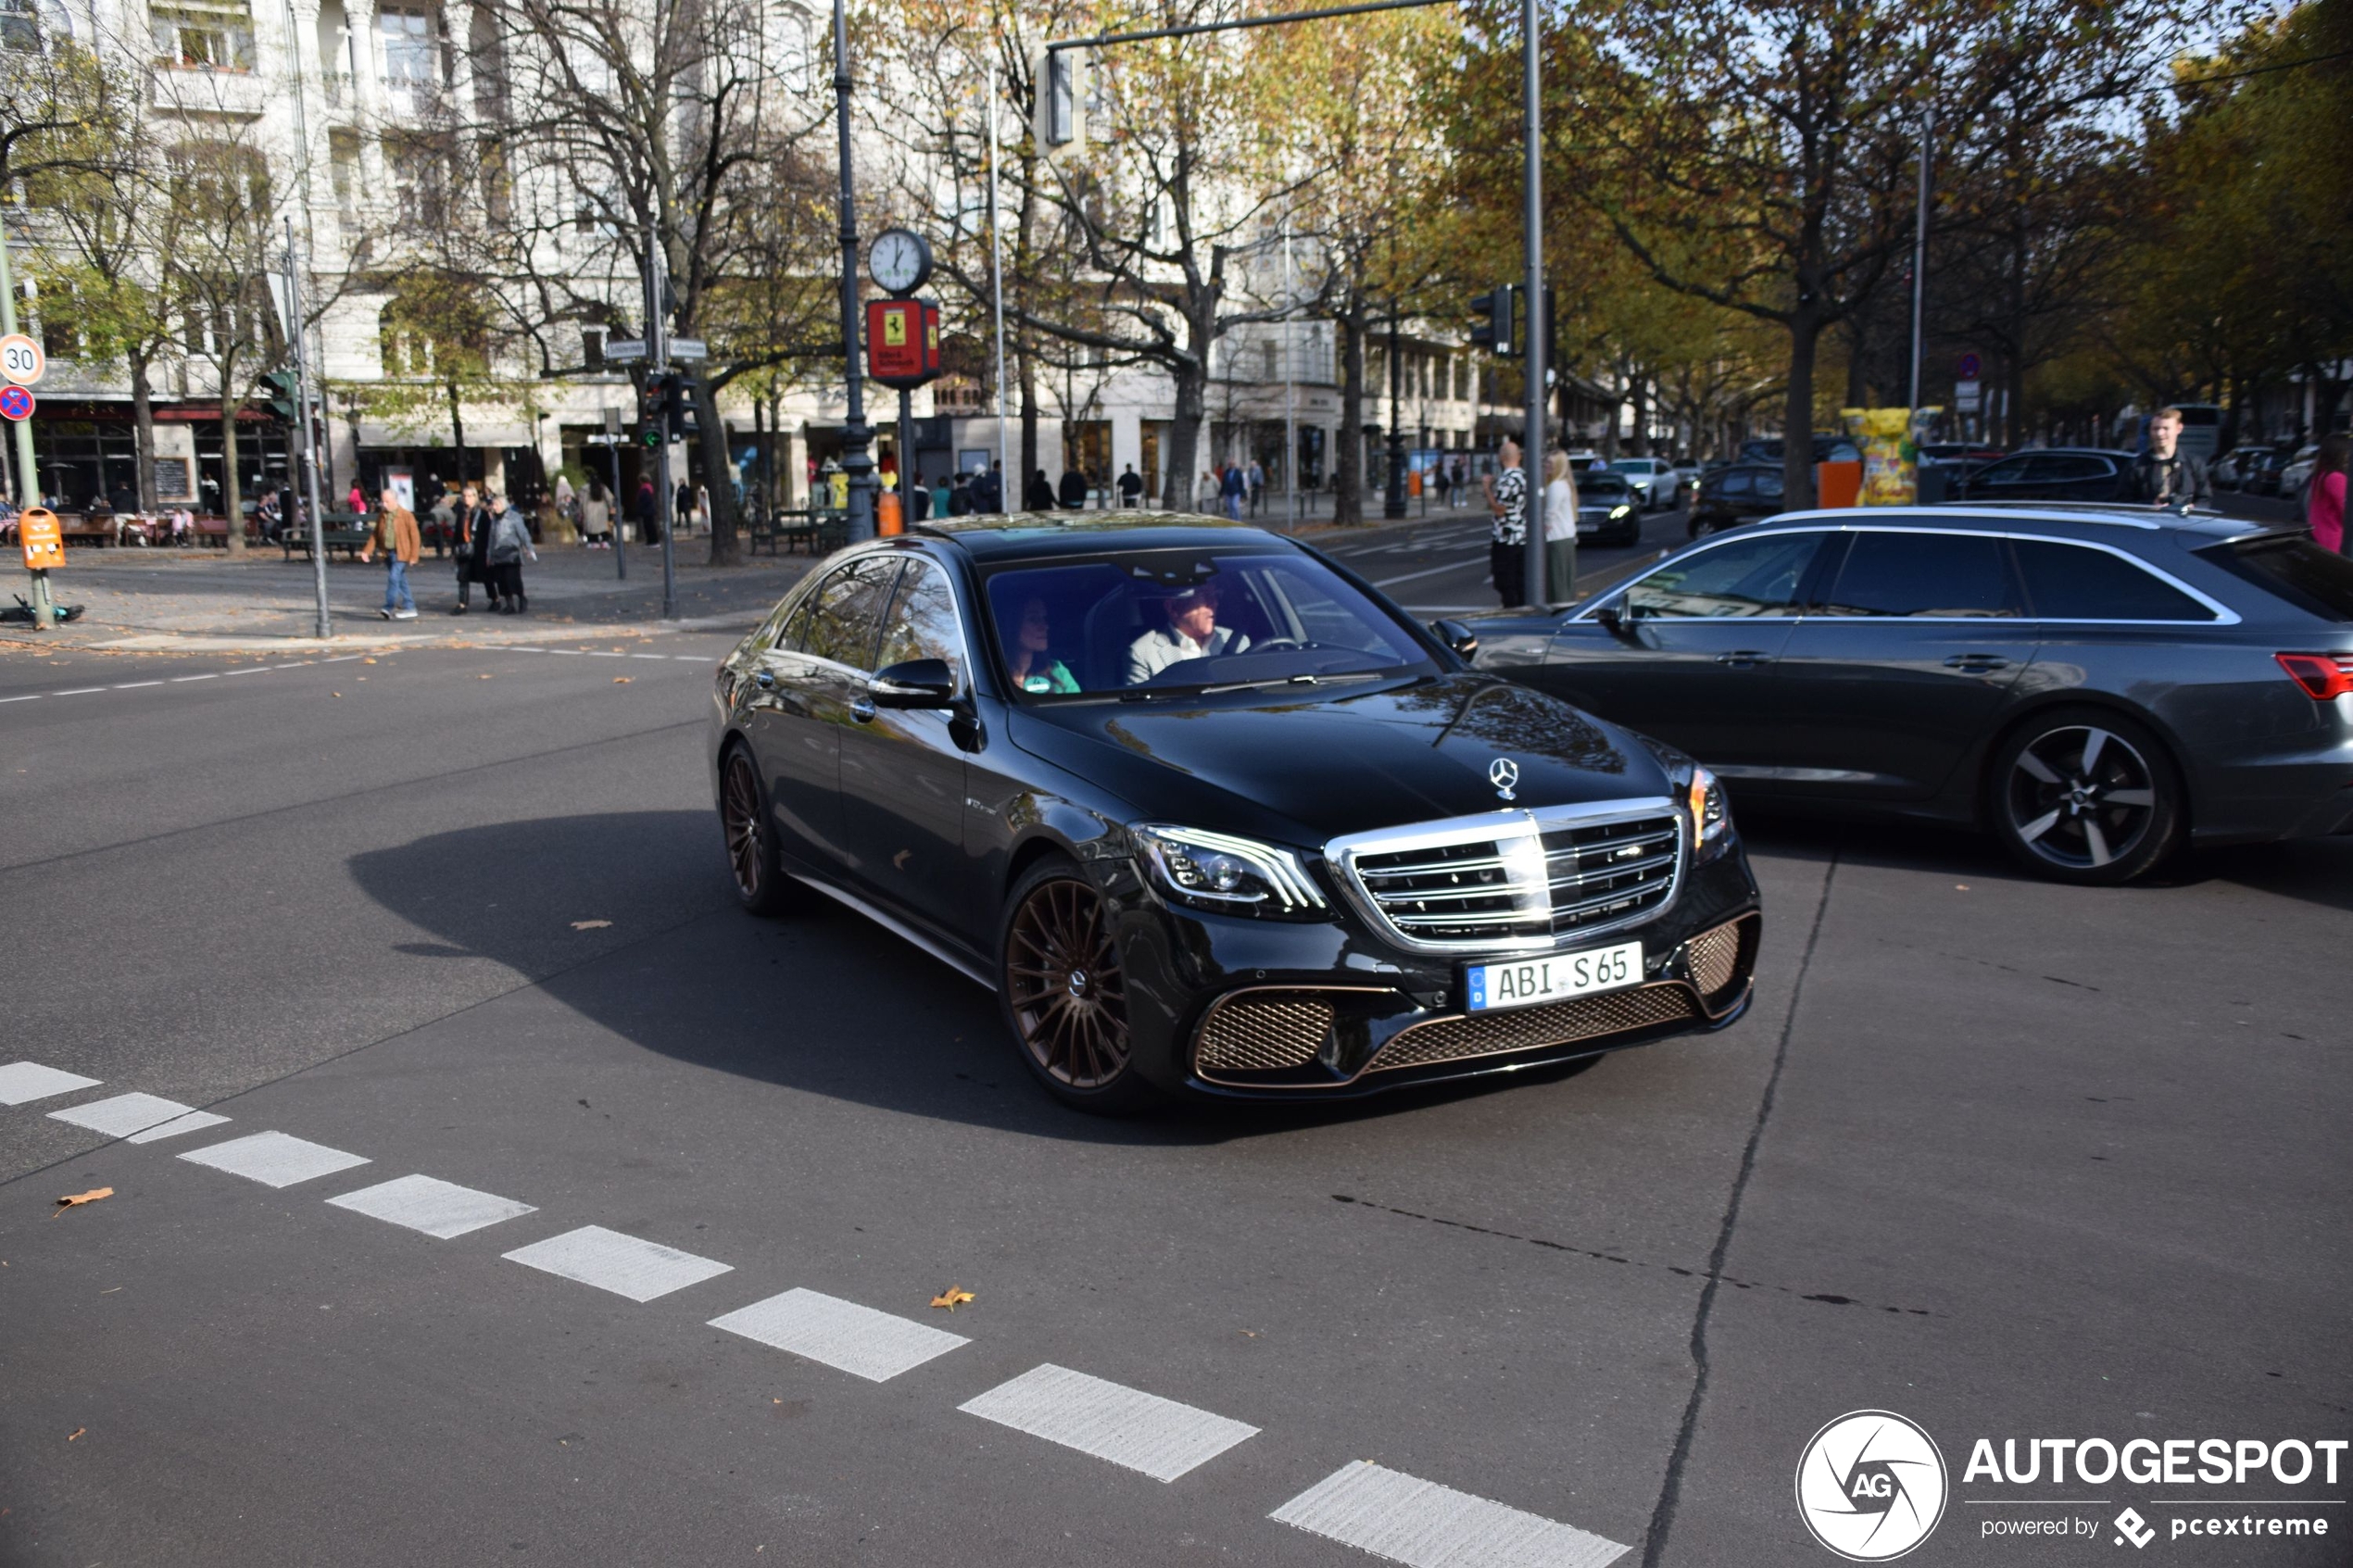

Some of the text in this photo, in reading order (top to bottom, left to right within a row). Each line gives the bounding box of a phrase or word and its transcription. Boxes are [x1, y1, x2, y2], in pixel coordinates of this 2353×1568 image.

[6, 348, 33, 370] 30
[1498, 963, 1553, 1000] ABI
[1473, 991, 1482, 1003] D
